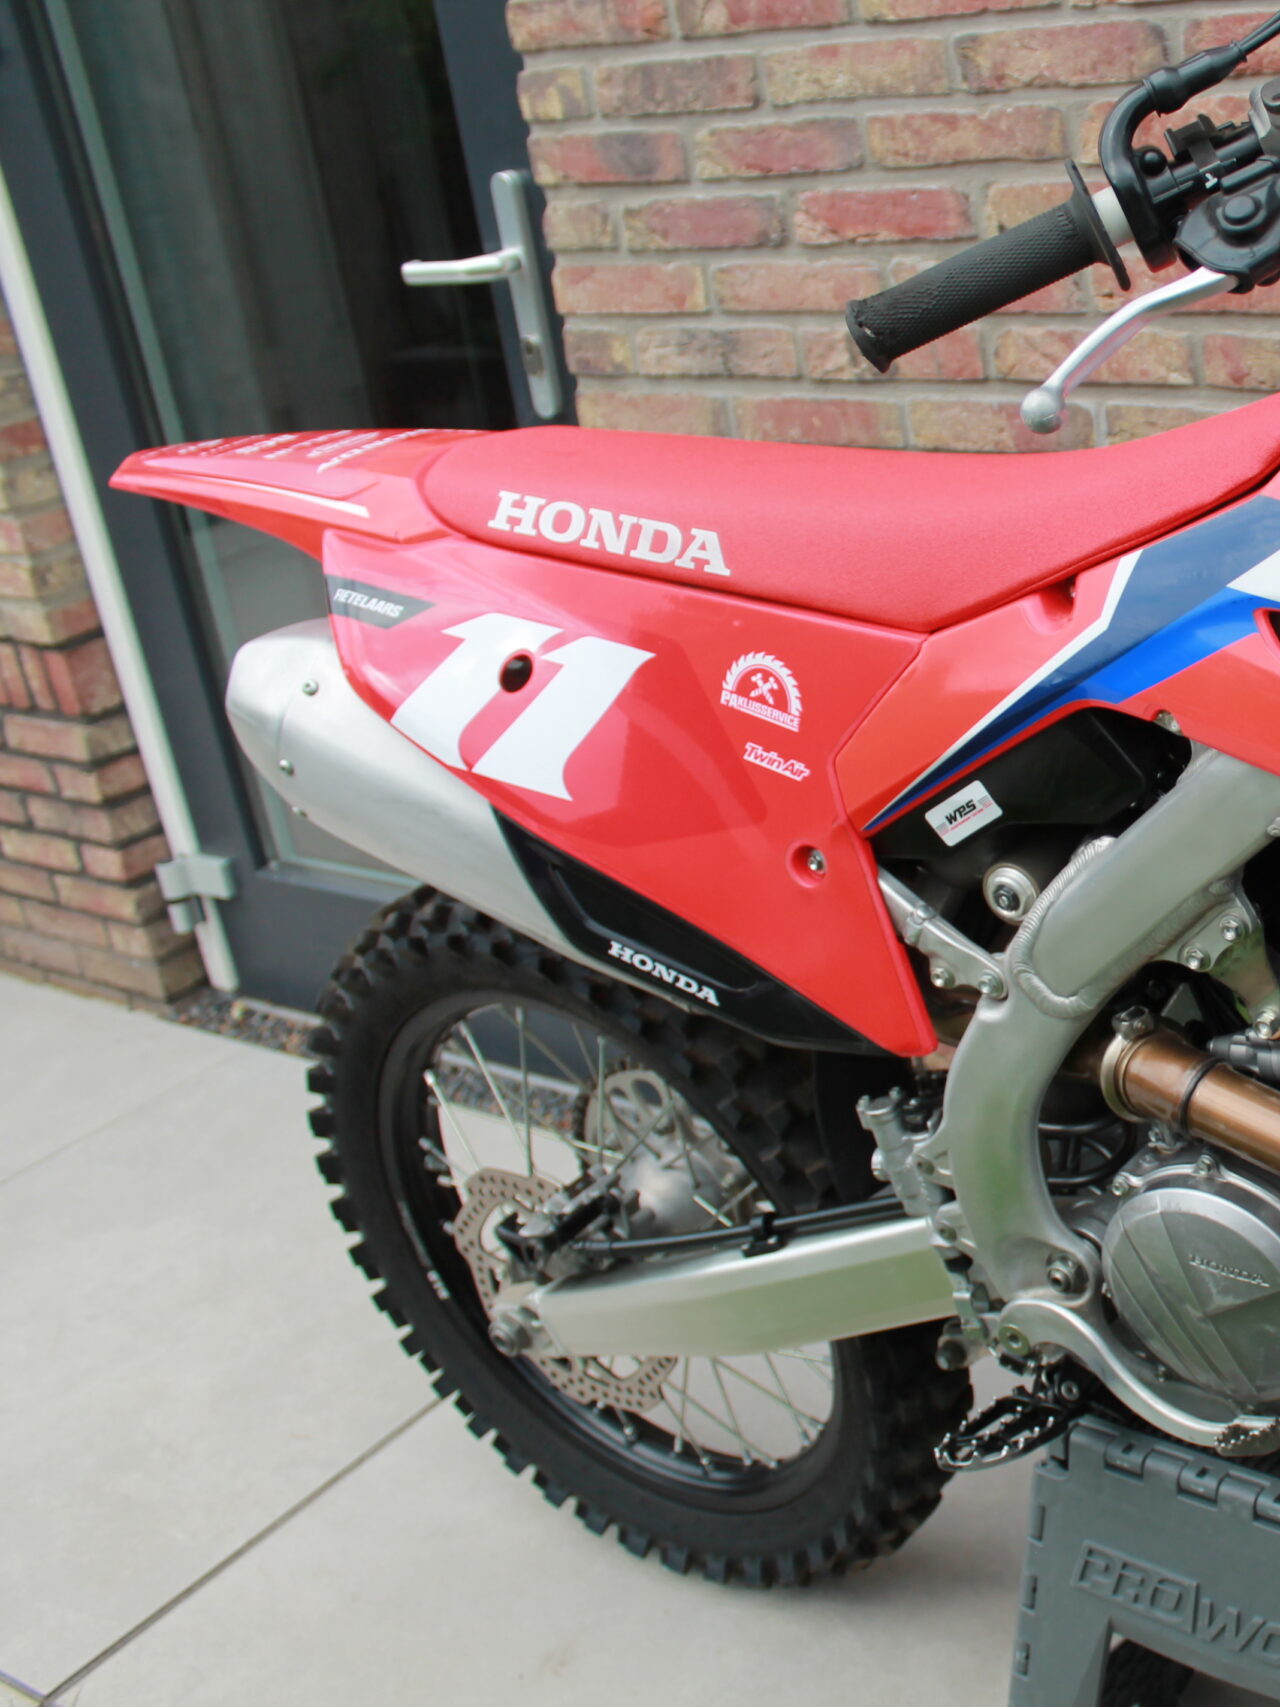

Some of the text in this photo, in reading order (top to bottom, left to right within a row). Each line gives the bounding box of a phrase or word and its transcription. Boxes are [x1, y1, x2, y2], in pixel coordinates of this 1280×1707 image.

[488, 490, 731, 576] HONDA
[390, 612, 655, 801] 11
[745, 744, 808, 779] Twin Air
[944, 799, 977, 825] WPS
[608, 940, 720, 1007] HONDA
